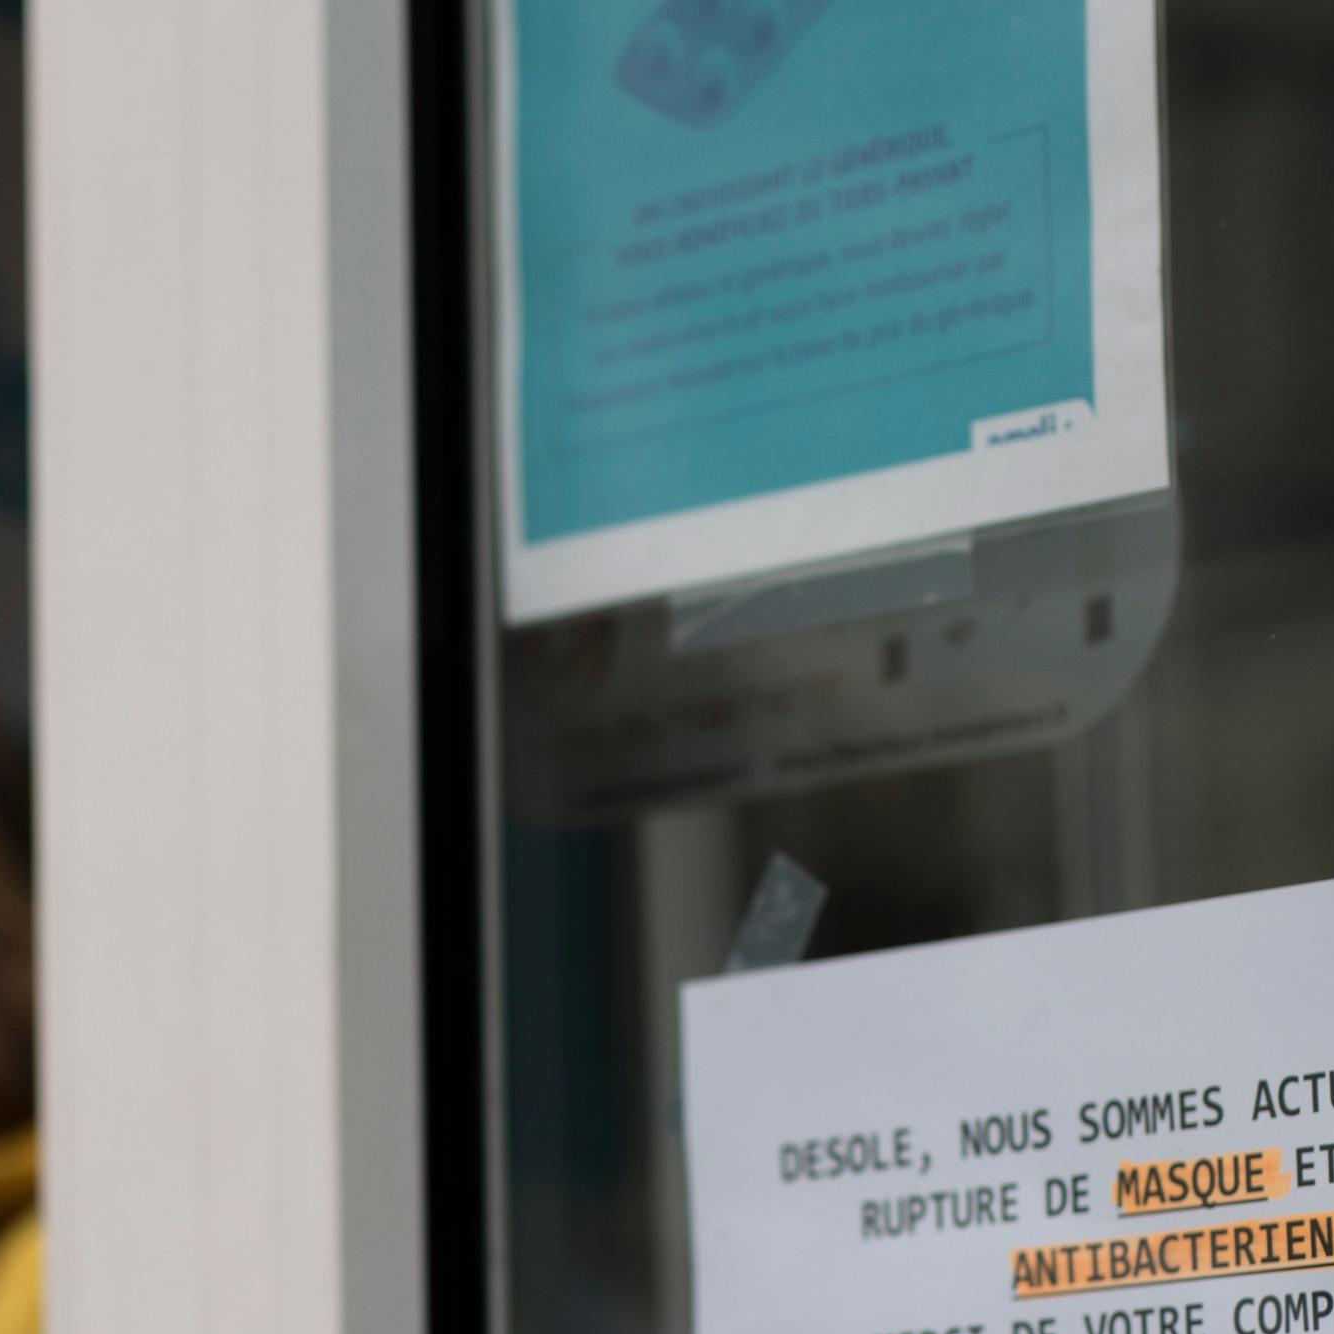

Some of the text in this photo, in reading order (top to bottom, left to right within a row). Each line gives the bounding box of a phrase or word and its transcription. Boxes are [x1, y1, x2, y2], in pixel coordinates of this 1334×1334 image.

[779, 1127, 931, 1183] DESOLE,
[960, 1108, 1052, 1156] NOUS
[1079, 1085, 1224, 1143] SOMMES
[861, 1182, 1018, 1236] RUPTURE
[1045, 1173, 1089, 1217] DE
[1117, 1152, 1268, 1219] MASQUE
